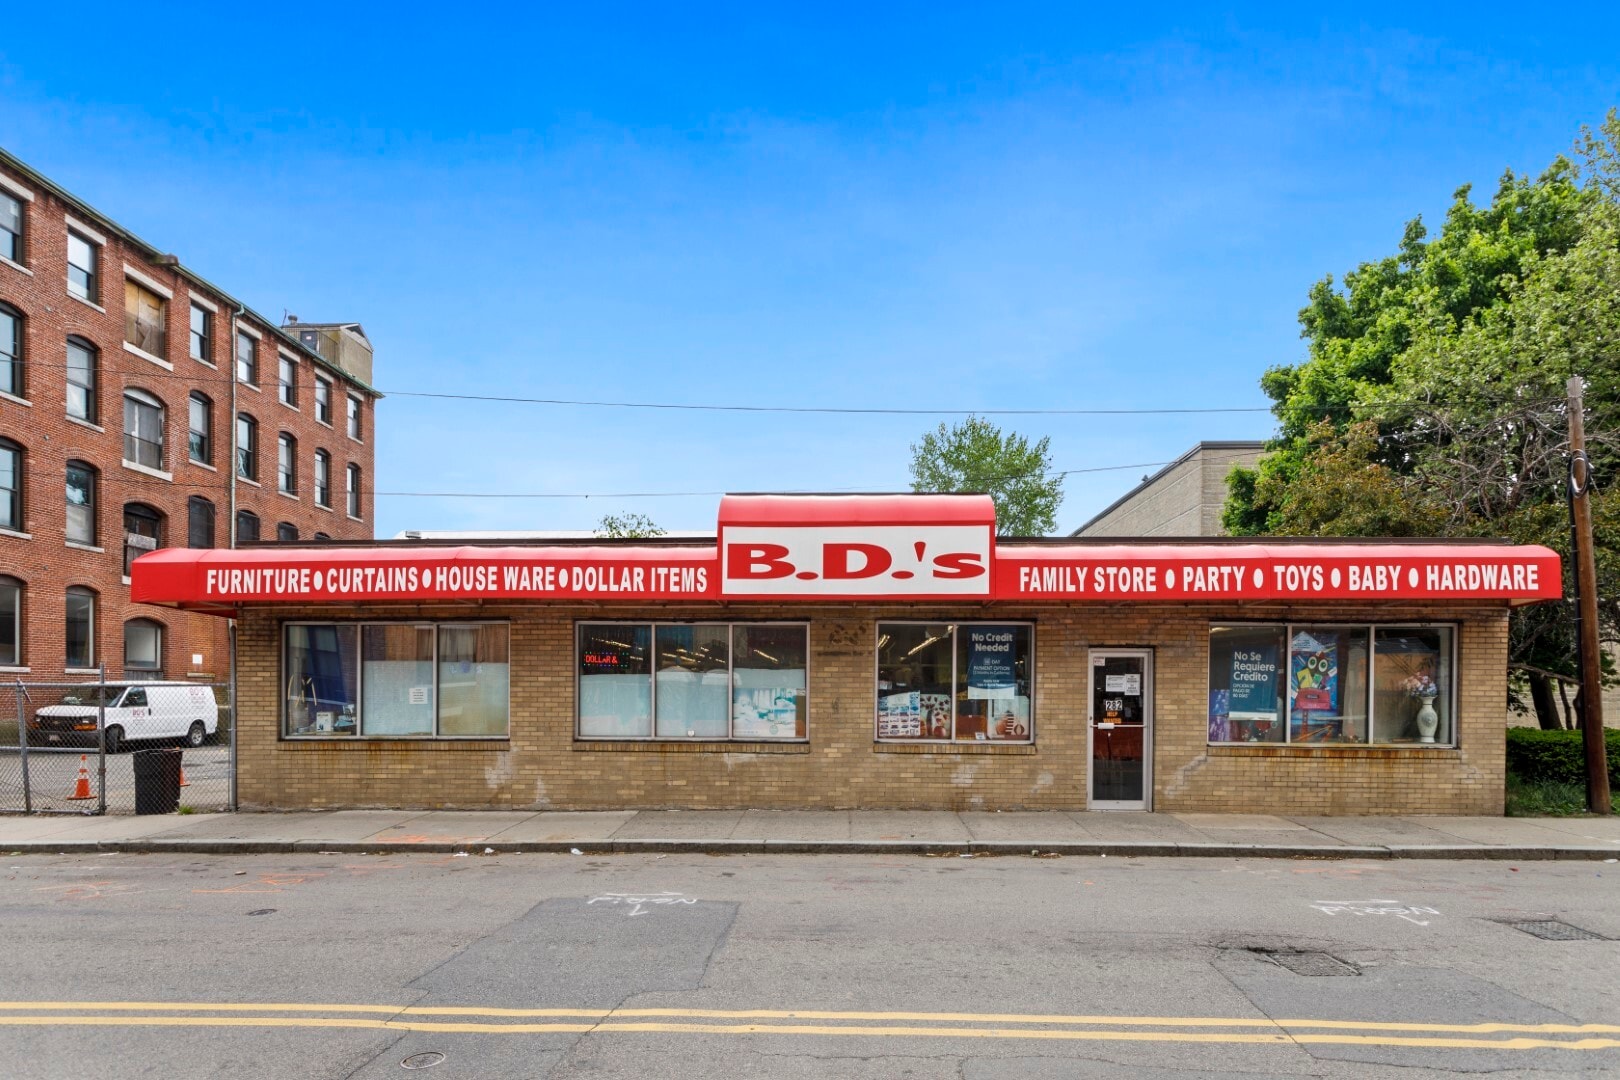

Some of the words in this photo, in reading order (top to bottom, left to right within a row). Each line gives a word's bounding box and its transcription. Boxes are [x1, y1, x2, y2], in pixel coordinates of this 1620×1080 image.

[727, 541, 986, 580] B.D.'s
[206, 569, 310, 594] FURNITURE
[327, 567, 418, 594] CURTAINS
[436, 566, 498, 591] HOUSE
[503, 566, 555, 591] WARE
[572, 566, 645, 592] DOLLAR
[651, 567, 707, 592] ITEMS
[1019, 566, 1088, 592] FAMILY
[1094, 566, 1157, 593] STORE
[1183, 565, 1246, 592] PARTY
[1273, 565, 1324, 592] TOYS
[1348, 565, 1402, 591] BABY
[1426, 564, 1539, 591] HARDWARE
[972, 633, 984, 642] No
[986, 633, 1013, 642] Credit
[975, 643, 1010, 652] Needed
[1234, 651, 1248, 661] No
[1250, 651, 1262, 661] Se
[1233, 661, 1276, 672] Requiere
[1106, 701, 1122, 711] 282
